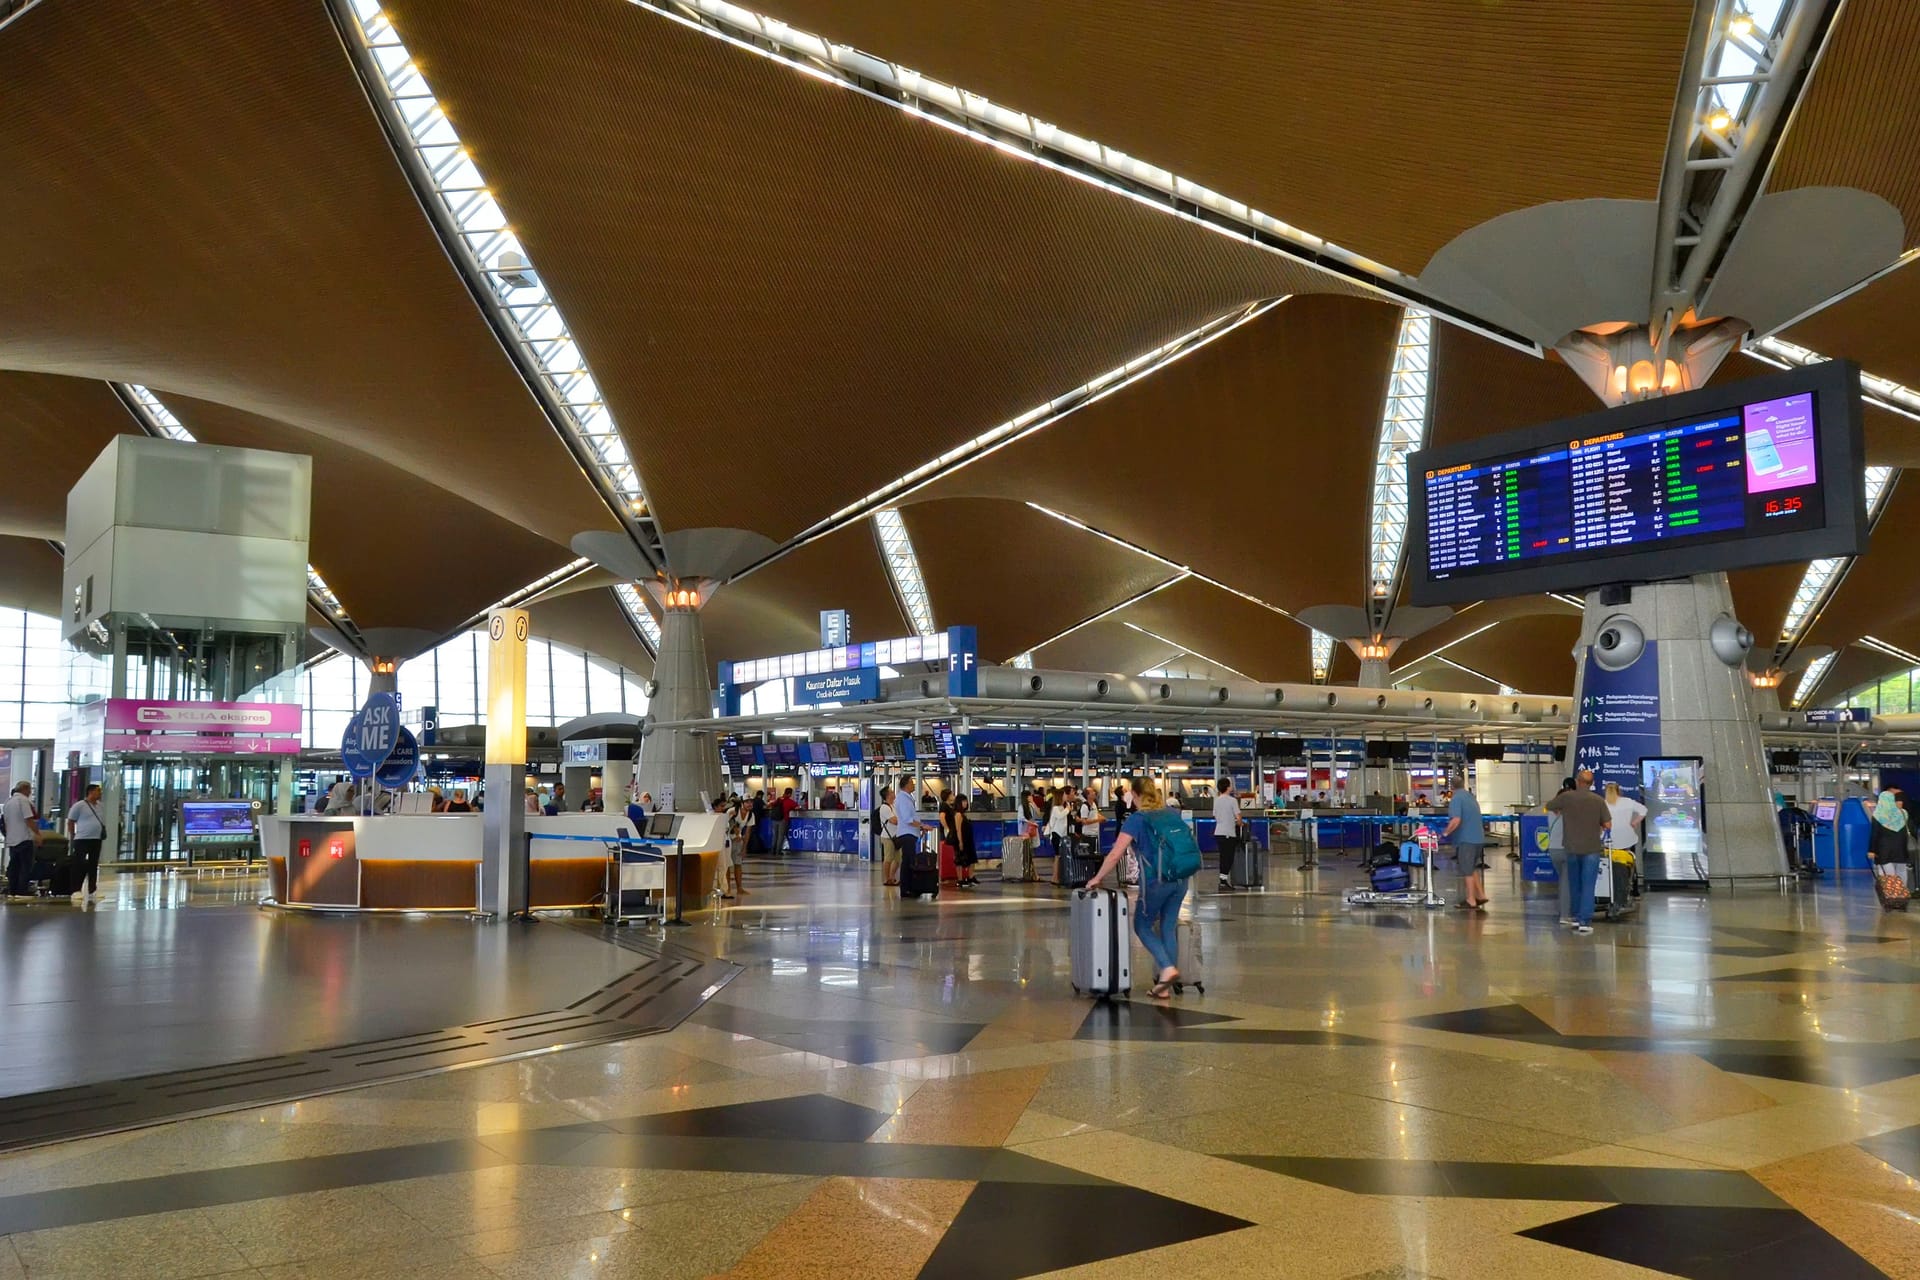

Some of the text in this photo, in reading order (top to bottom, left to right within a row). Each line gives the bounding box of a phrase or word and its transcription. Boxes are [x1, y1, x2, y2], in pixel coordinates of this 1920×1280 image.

[1583, 433, 1625, 445] DEPARTURES
[1438, 464, 1471, 475] DEPARTURES
[828, 614, 839, 628] E
[828, 629, 839, 644] F
[951, 653, 957, 672] F
[964, 653, 973, 671] F
[843, 674, 861, 686] Masuk
[719, 683, 725, 697] E
[178, 711, 266, 724] KLIA ekspres
[363, 706, 390, 725] ASK
[426, 720, 435, 730] D
[361, 725, 389, 750] ME
[813, 829, 823, 840] TO
